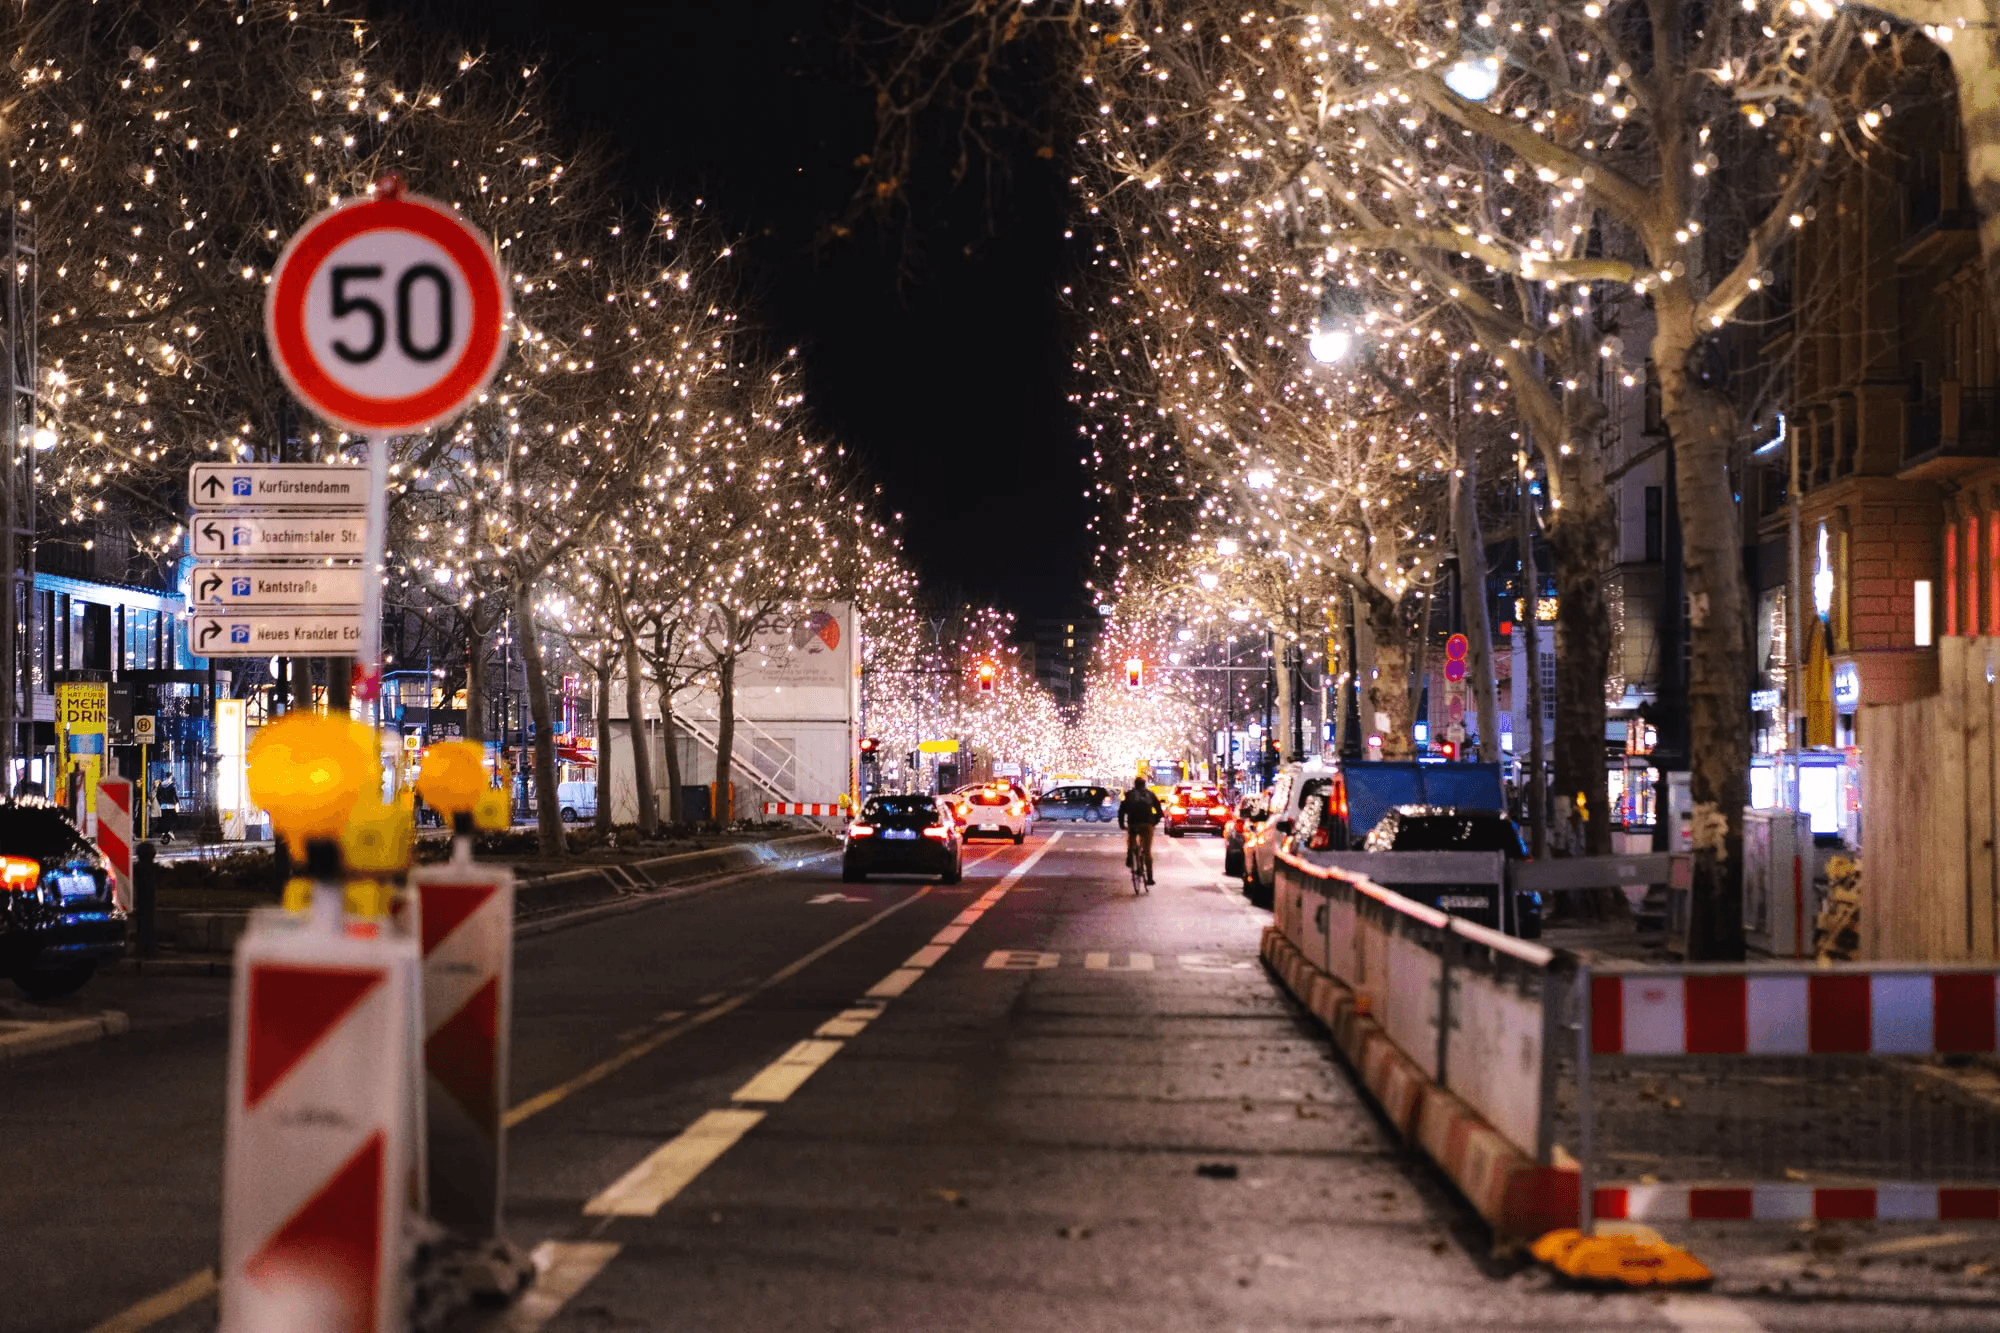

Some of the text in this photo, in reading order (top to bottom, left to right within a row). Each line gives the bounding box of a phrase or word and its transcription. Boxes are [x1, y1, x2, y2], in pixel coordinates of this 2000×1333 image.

[330, 263, 453, 363] 50
[258, 479, 350, 494] Kurfürstendamm
[261, 530, 335, 543] Joachimstaler
[341, 530, 360, 543] Str.
[258, 580, 318, 593] Kantstraße
[257, 628, 290, 640] Neues
[294, 627, 338, 640] Kranzler
